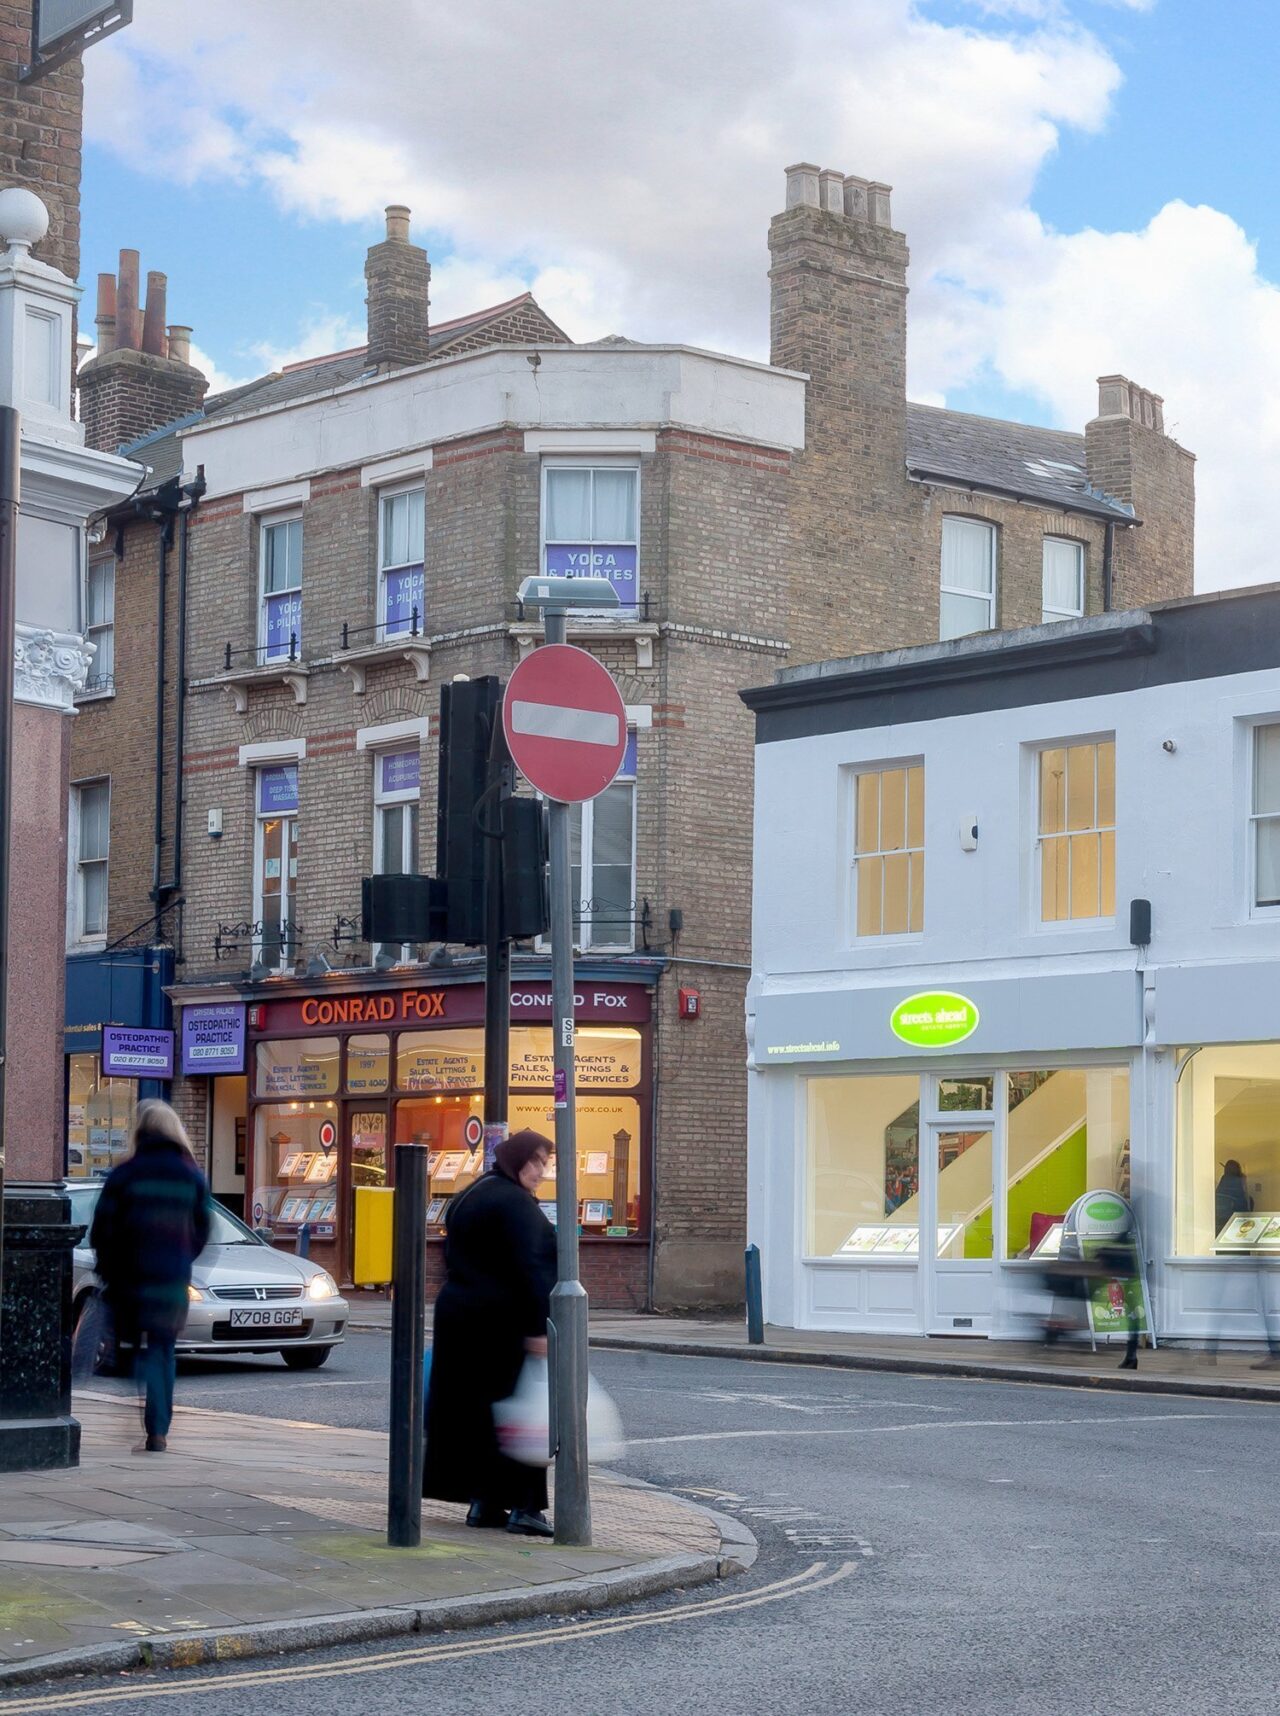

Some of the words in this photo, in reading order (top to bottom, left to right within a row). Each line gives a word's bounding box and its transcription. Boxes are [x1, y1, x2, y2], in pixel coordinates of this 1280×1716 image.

[568, 553, 616, 566] YOGA
[398, 575, 424, 590] YOGA
[510, 992, 585, 1007] COND
[593, 992, 628, 1008] FOX
[193, 1007, 214, 1017] CRYSTAL
[216, 1006, 236, 1016] PALACE
[301, 996, 396, 1025] CONRAD
[402, 990, 446, 1018] FOX
[900, 1010, 933, 1026] streets
[935, 1006, 967, 1023] ahead
[188, 1018, 241, 1032] OSTEOPATHIC
[565, 1019, 573, 1031] S
[110, 1032, 169, 1044] OSTEOPATHIC
[195, 1032, 233, 1044] PRACTICE
[565, 1034, 573, 1045] 8
[118, 1043, 161, 1054] PRACTICE
[192, 1048, 204, 1057] 020
[204, 1047, 219, 1056] 8771
[768, 1040, 840, 1055] www.streetsahead.info
[113, 1056, 127, 1064] 020
[417, 1057, 438, 1065] ESTATE
[443, 1056, 469, 1064] AGENTS
[524, 1054, 554, 1063] ESTAT
[574, 1055, 616, 1063] AGENTS
[436, 1066, 466, 1074] LETTINGS
[471, 1064, 477, 1073] &
[511, 1063, 549, 1073] SALES,
[574, 1065, 611, 1073] TTINGS
[620, 1065, 630, 1073] &
[368, 1078, 387, 1087] 4040
[447, 1075, 477, 1083] SERVICES
[511, 1073, 555, 1082] FINANCI
[578, 1074, 629, 1083] SERVICES
[234, 1311, 271, 1325] X708
[274, 1309, 300, 1324] GGF
